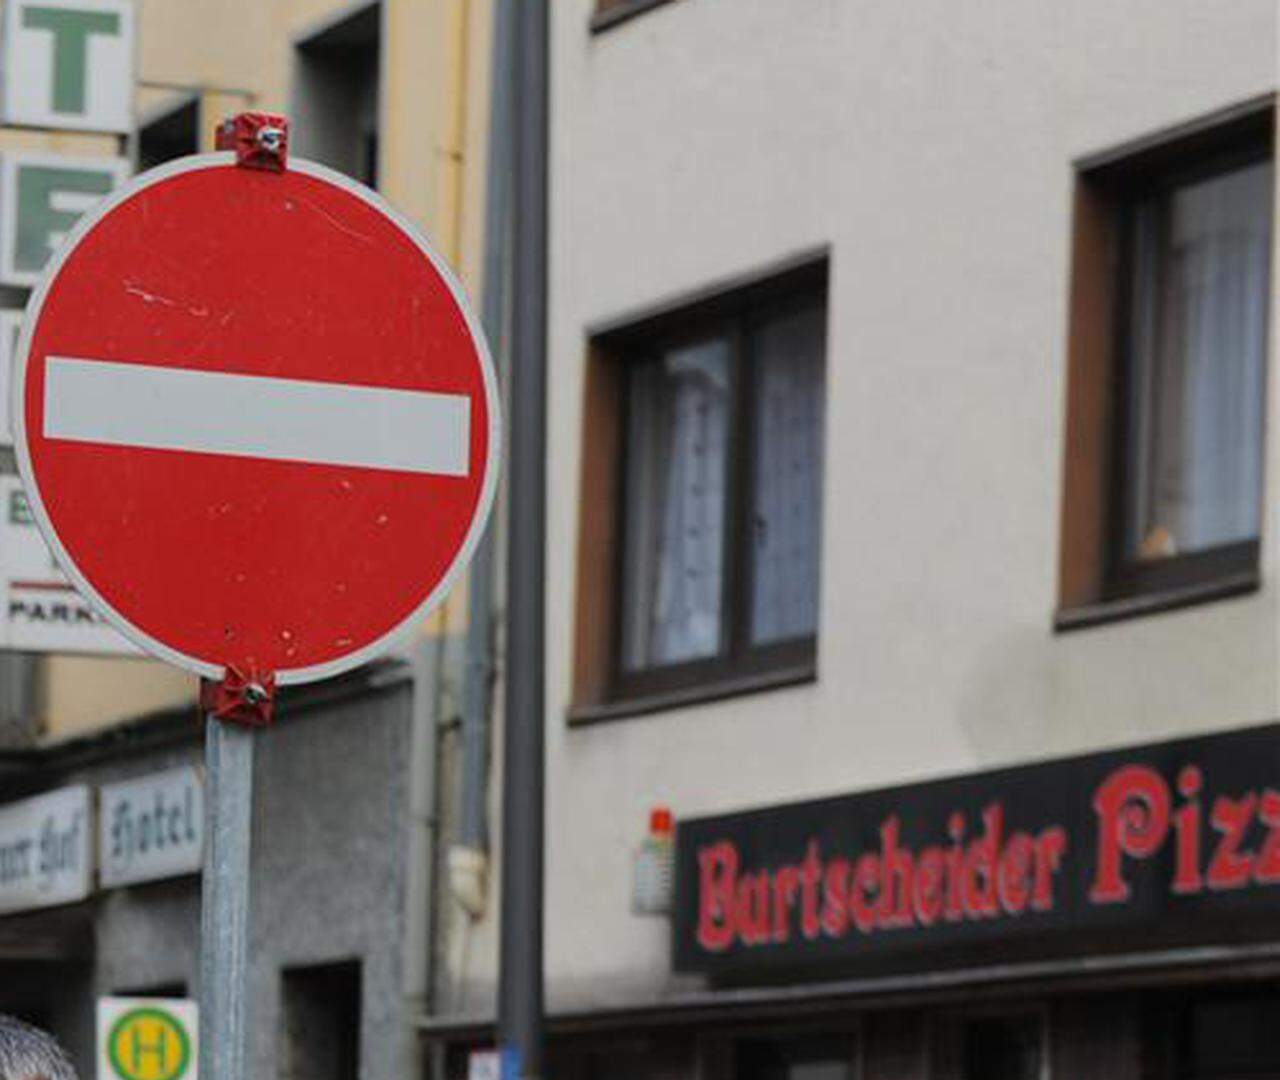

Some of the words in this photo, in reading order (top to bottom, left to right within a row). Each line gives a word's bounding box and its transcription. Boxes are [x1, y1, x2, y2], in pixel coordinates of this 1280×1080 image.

[10, 602, 94, 623] PARK
[111, 786, 195, 863] Hotel
[696, 801, 1067, 952] Burtscheider
[131, 1023, 168, 1074] H
